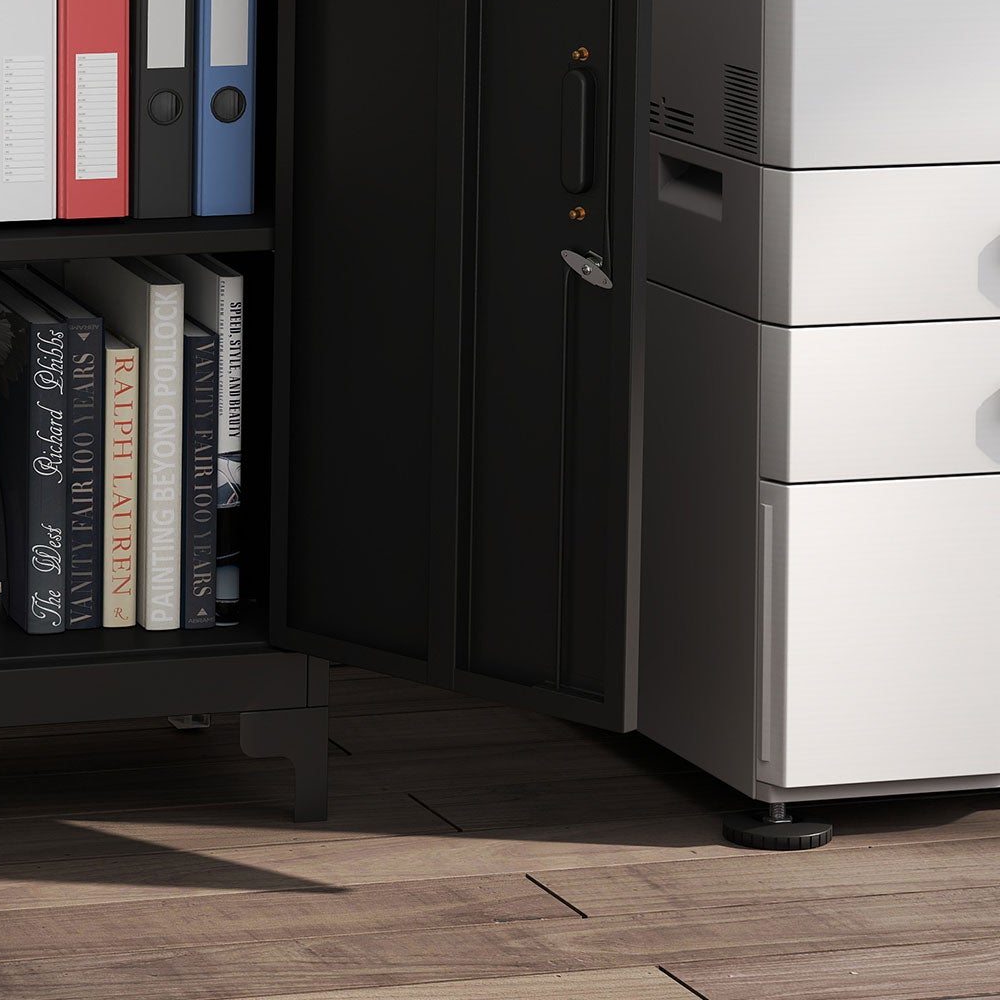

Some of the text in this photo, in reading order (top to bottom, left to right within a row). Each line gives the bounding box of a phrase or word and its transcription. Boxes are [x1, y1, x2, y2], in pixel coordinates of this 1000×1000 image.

[33, 329, 65, 484] Richard Phibbs
[72, 352, 96, 427] YEARS
[194, 341, 215, 421] VANITY
[228, 301, 242, 438] SPEED, STYLE, AND BEAUTY
[111, 355, 135, 596] RALPH LAUREN
[151, 291, 178, 623] PAINTING BEYOND POLLOCK
[193, 429, 214, 479] FAIR
[71, 479, 94, 532] FAIR
[31, 522, 62, 627] The West
[70, 539, 94, 626] VANITY
[192, 529, 212, 598] YEARS
